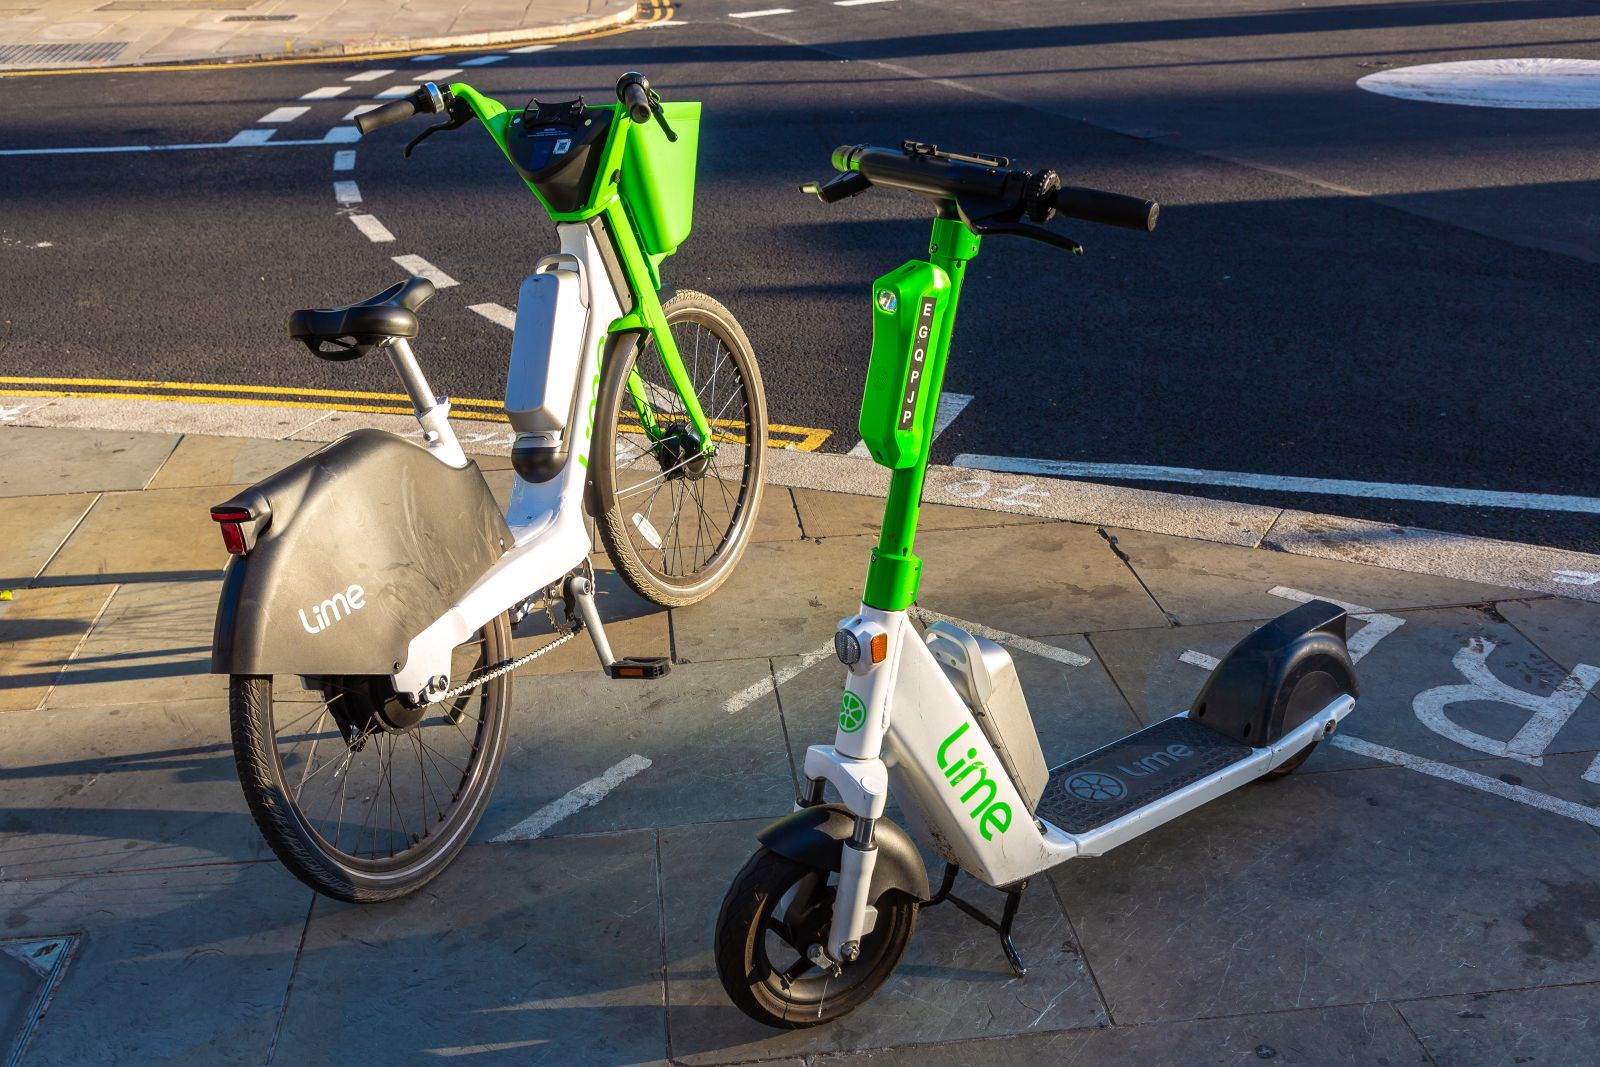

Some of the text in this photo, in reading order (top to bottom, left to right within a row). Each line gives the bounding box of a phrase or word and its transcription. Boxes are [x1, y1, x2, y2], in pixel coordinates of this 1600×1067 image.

[903, 303, 932, 424] EGQPJP
[298, 584, 366, 634] Lime
[937, 721, 1012, 841] Lime
[1117, 744, 1195, 777] Lime
